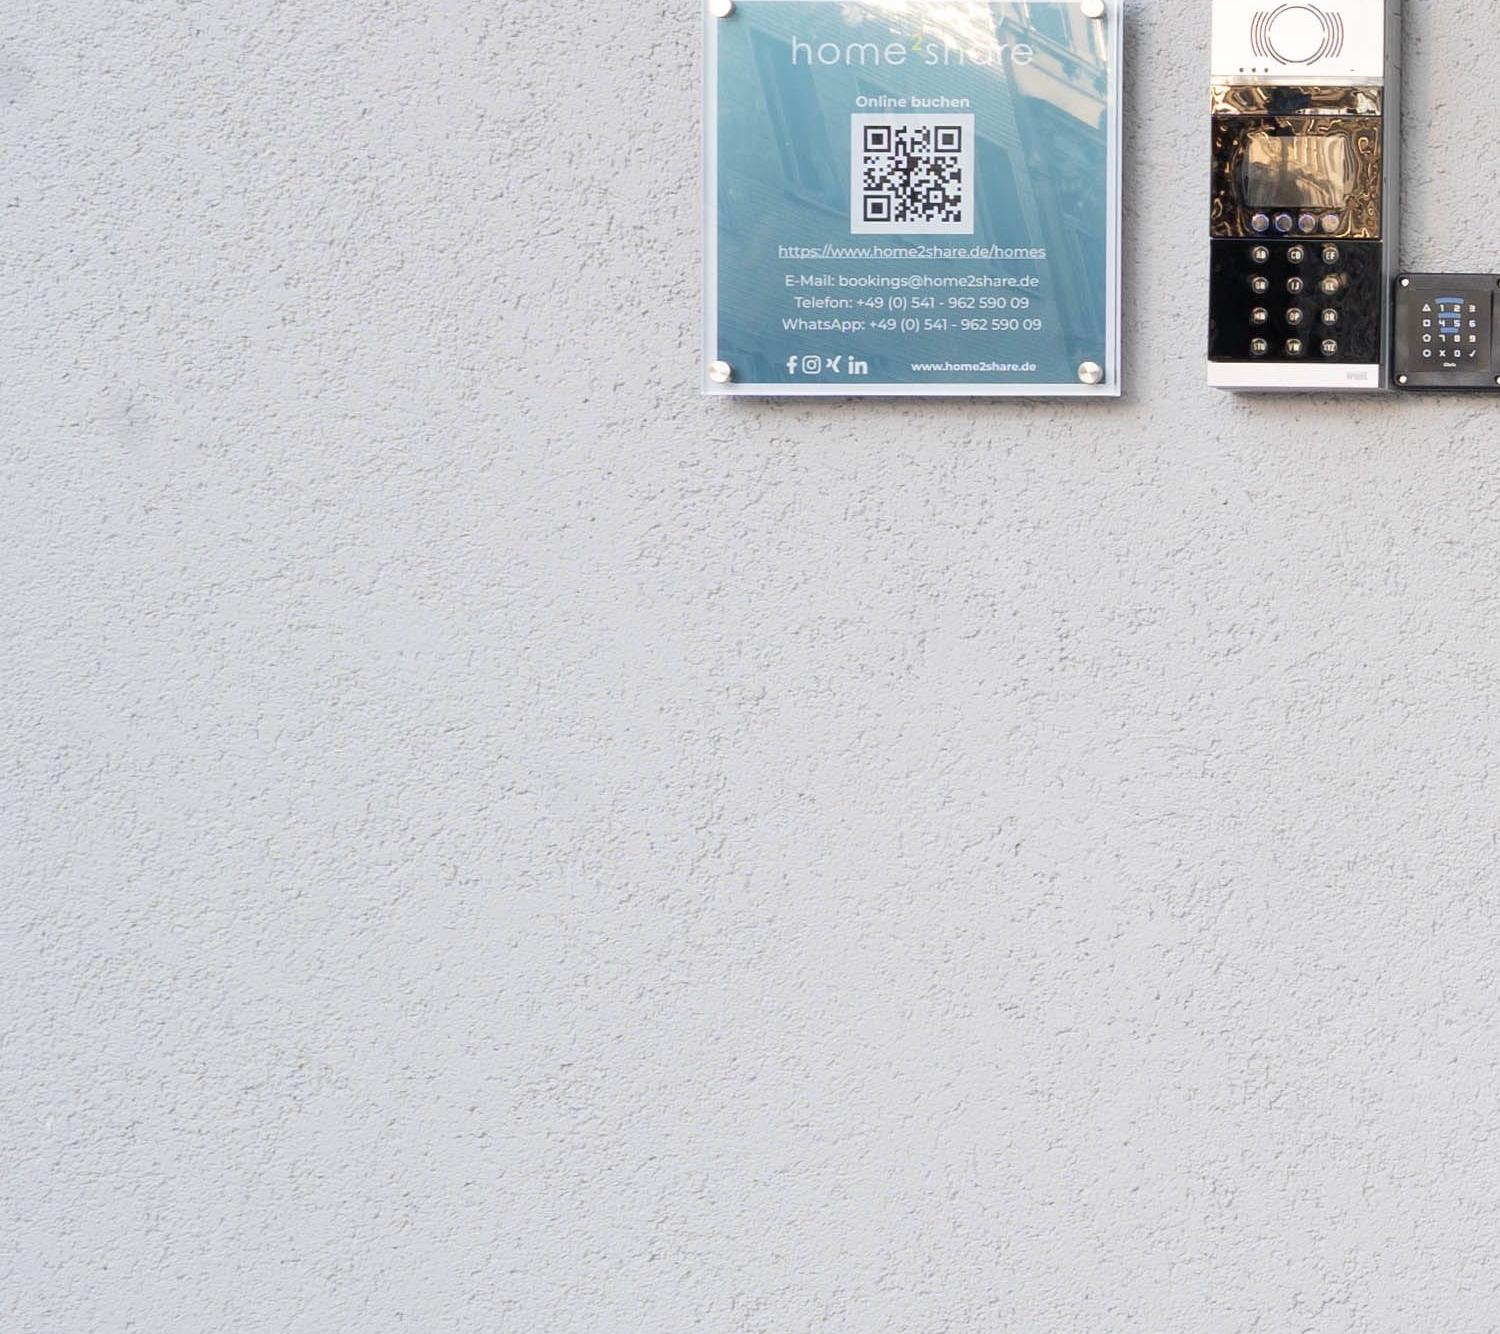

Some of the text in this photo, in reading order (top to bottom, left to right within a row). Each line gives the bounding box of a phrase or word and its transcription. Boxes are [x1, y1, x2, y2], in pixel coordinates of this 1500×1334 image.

[855, 95, 971, 108] Online buchen
[778, 244, 1047, 259] https://www.home2share.de/homes
[785, 274, 1040, 289] E-Mail: bookings@home2share.de
[793, 296, 853, 309] Telefon:
[856, 296, 884, 309] +49
[888, 296, 907, 311] (0)
[911, 296, 935, 309] 541
[948, 297, 976, 309] 962
[979, 297, 1007, 309] 590
[1010, 297, 1030, 309] 09
[1453, 304, 1461, 312] 2
[1468, 304, 1476, 312] 3
[781, 318, 865, 332] WhatsApp:
[869, 318, 897, 331] +49
[900, 318, 920, 333] (0)
[924, 318, 948, 331] 541
[960, 318, 988, 331] 962
[991, 318, 1019, 331] 590
[1022, 318, 1042, 331] 09
[1438, 319, 1476, 327] 4 5 6
[1438, 334, 1476, 342] 7 8 9
[911, 361, 1037, 372] www.home2share.de
